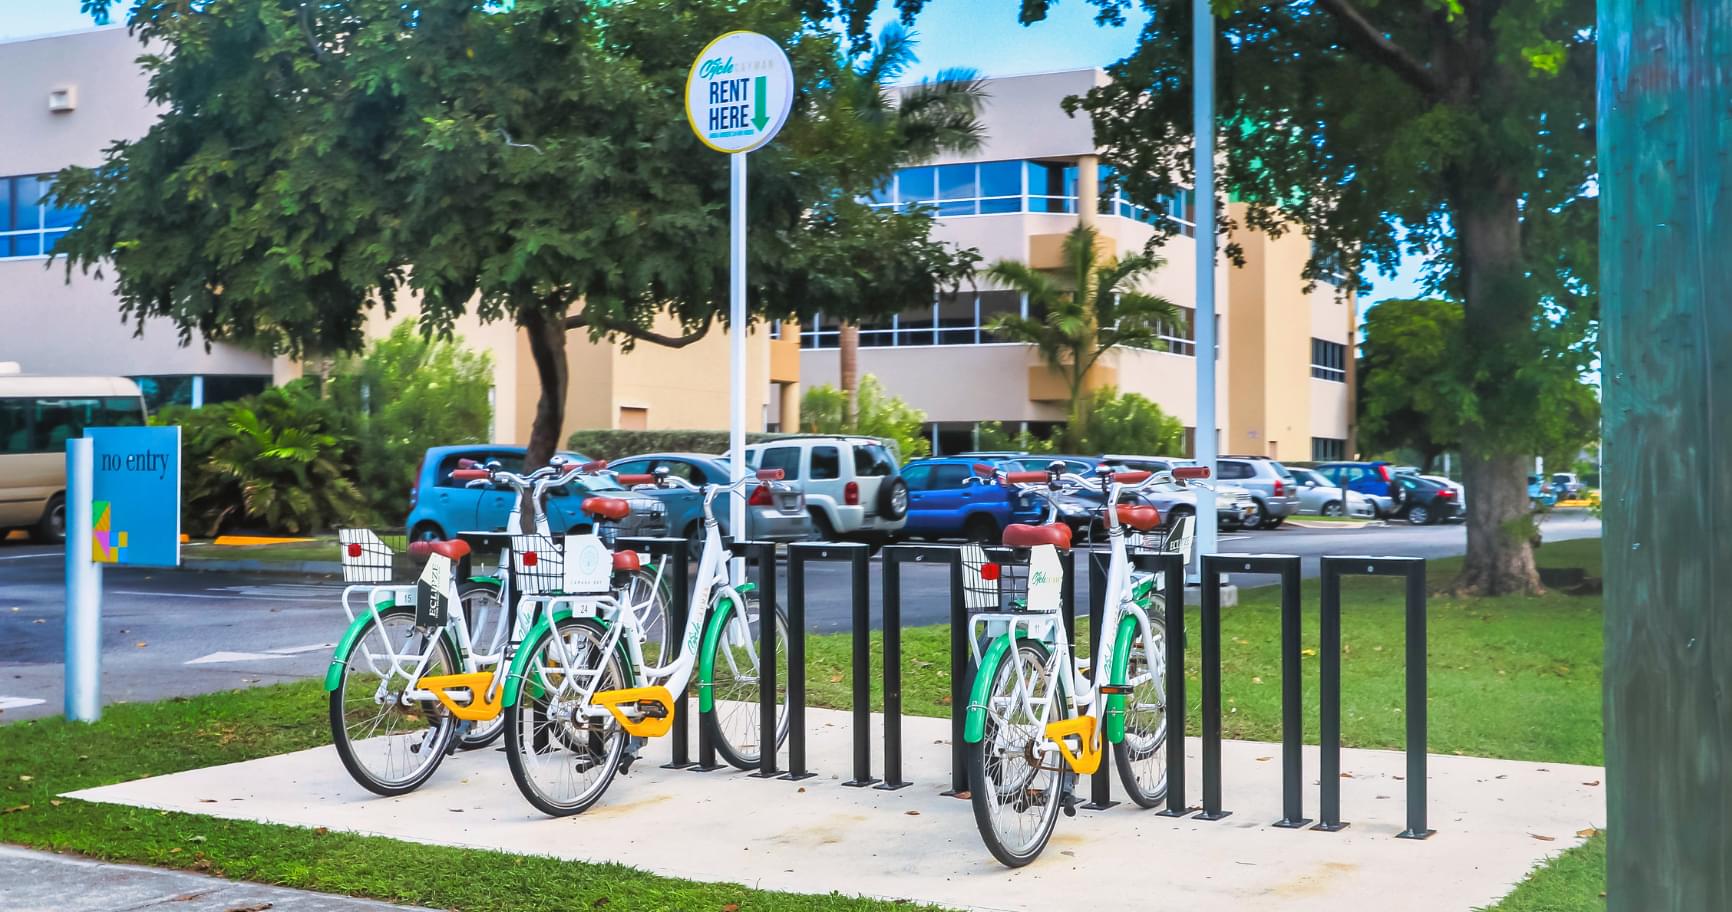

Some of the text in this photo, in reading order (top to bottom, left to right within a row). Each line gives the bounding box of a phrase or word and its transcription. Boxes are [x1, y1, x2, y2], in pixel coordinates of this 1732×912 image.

[700, 56, 733, 79] Cycle
[709, 78, 750, 104] RENT
[709, 105, 749, 130] HERE
[102, 449, 169, 480] no entry
[580, 604, 588, 613] 24
